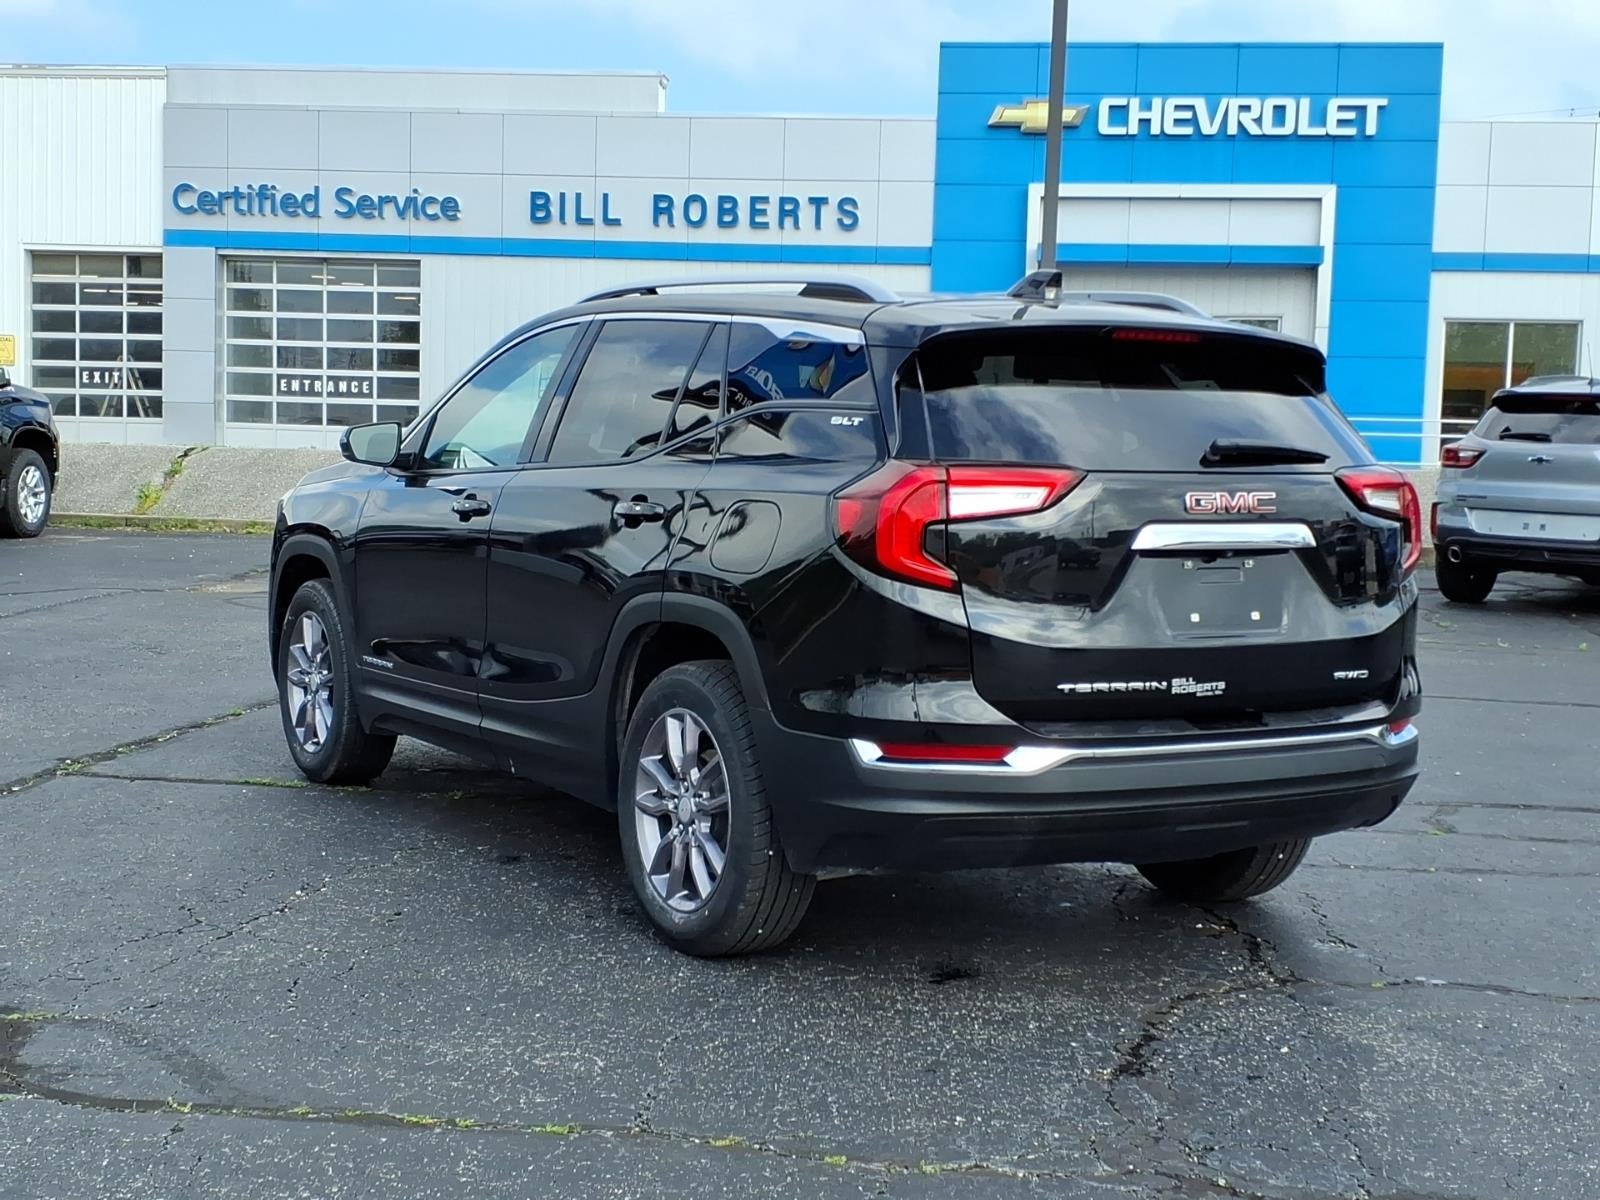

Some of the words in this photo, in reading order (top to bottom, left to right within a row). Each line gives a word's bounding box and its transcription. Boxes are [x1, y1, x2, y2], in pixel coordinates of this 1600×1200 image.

[1098, 97, 1389, 136] CHEVROLET
[171, 182, 321, 217] Certified
[333, 186, 461, 221] Service
[529, 191, 622, 226] BILL
[652, 193, 860, 231] ROBERTS
[82, 370, 120, 384] EXIT
[280, 378, 370, 394] ENTRANCE
[830, 416, 864, 426] SLT
[1184, 491, 1277, 514] GMC
[1171, 677, 1196, 686] BILL
[1333, 669, 1369, 680] AWD
[1057, 681, 1168, 694] TERRAIN
[1171, 681, 1226, 695] ROBERTS
